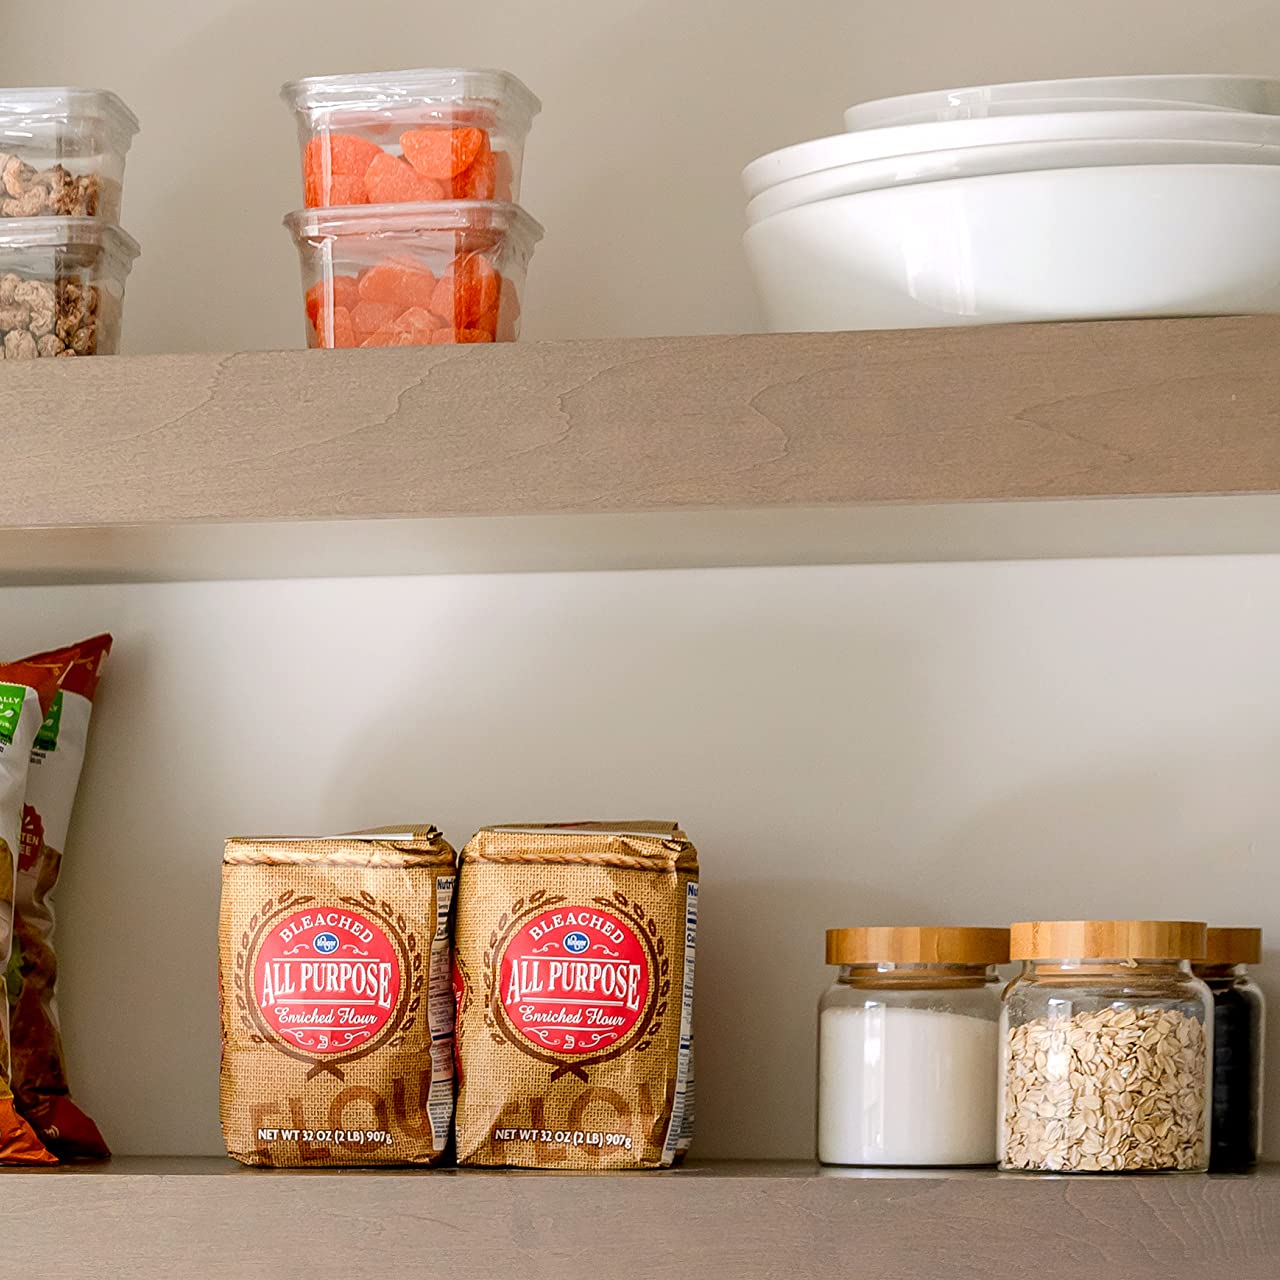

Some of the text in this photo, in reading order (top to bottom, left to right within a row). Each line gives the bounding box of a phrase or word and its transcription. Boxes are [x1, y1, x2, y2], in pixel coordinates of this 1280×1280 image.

[21, 833, 39, 846] TEN
[20, 844, 32, 856] EE
[279, 913, 375, 944] BLEACHED
[528, 911, 626, 944] BLEACHED
[316, 936, 337, 950] Kroger
[566, 936, 587, 950] Kroger
[261, 961, 393, 1009] ALL PURPOSE
[506, 959, 641, 1011] ALL PURPOSE
[274, 1006, 379, 1024] Enriched Flour
[519, 1005, 626, 1026] Enriched Flour
[257, 1128, 392, 1145] NET WT 32 OZ (2 LB) 907g
[495, 1129, 632, 1149] NET WT 32 OZ (2 LB) 907g
